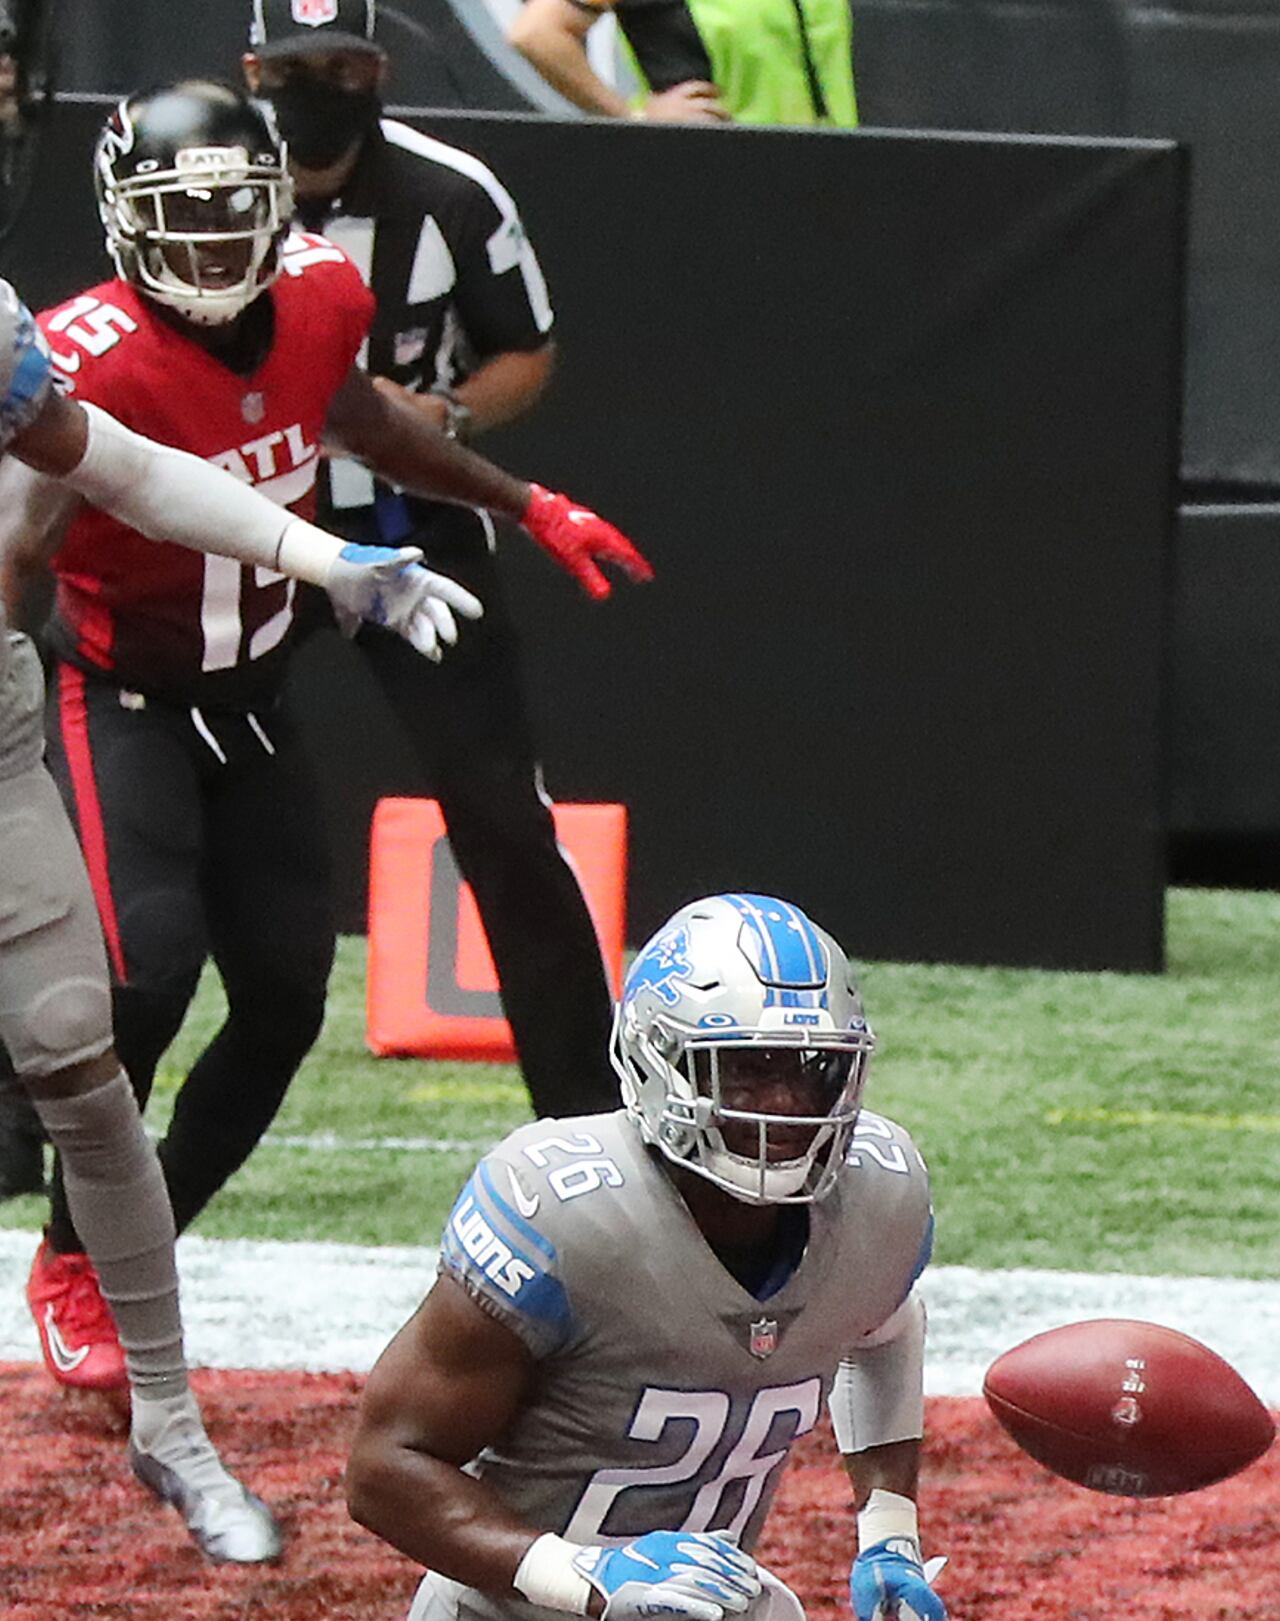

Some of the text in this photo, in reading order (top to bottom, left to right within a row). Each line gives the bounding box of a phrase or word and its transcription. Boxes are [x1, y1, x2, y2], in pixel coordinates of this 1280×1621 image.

[46, 295, 139, 357] 15
[521, 1132, 626, 1203] 26
[452, 1196, 536, 1298] LIONS
[563, 1376, 822, 1549] 26
